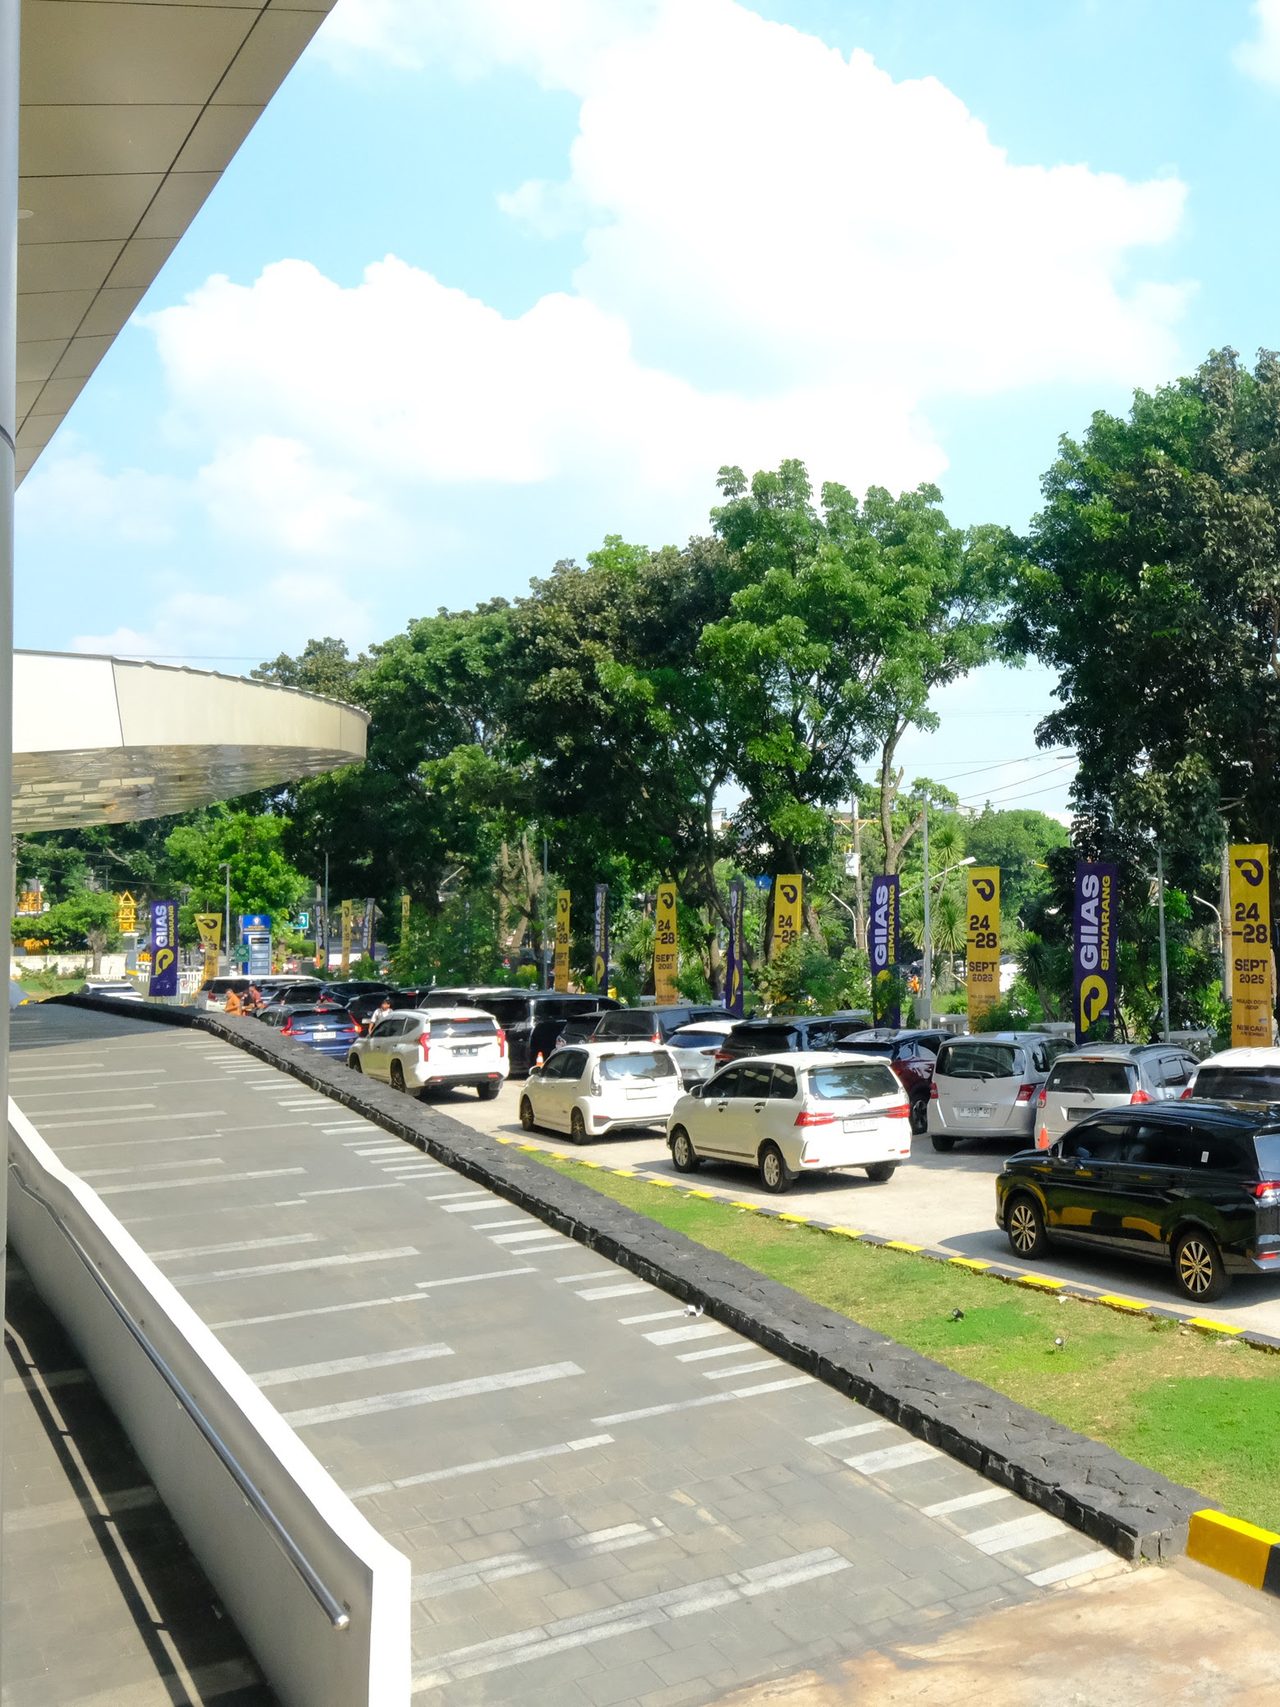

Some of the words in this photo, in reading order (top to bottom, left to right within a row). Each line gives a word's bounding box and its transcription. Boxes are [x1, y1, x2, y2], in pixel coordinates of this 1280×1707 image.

[1235, 902, 1260, 922] 24
[155, 905, 167, 947] GIIAS
[657, 920, 671, 931] 24
[778, 915, 793, 928] 24
[874, 885, 889, 966] GIIAS
[888, 884, 896, 965] SEMARANG
[970, 915, 990, 931] 24
[1080, 874, 1099, 970] GIIAS
[1101, 875, 1111, 971] SEMARANG
[656, 954, 675, 962] SEPT
[1235, 958, 1268, 973] SEPT
[969, 962, 997, 973] SEPT
[1239, 974, 1265, 985] 2025
